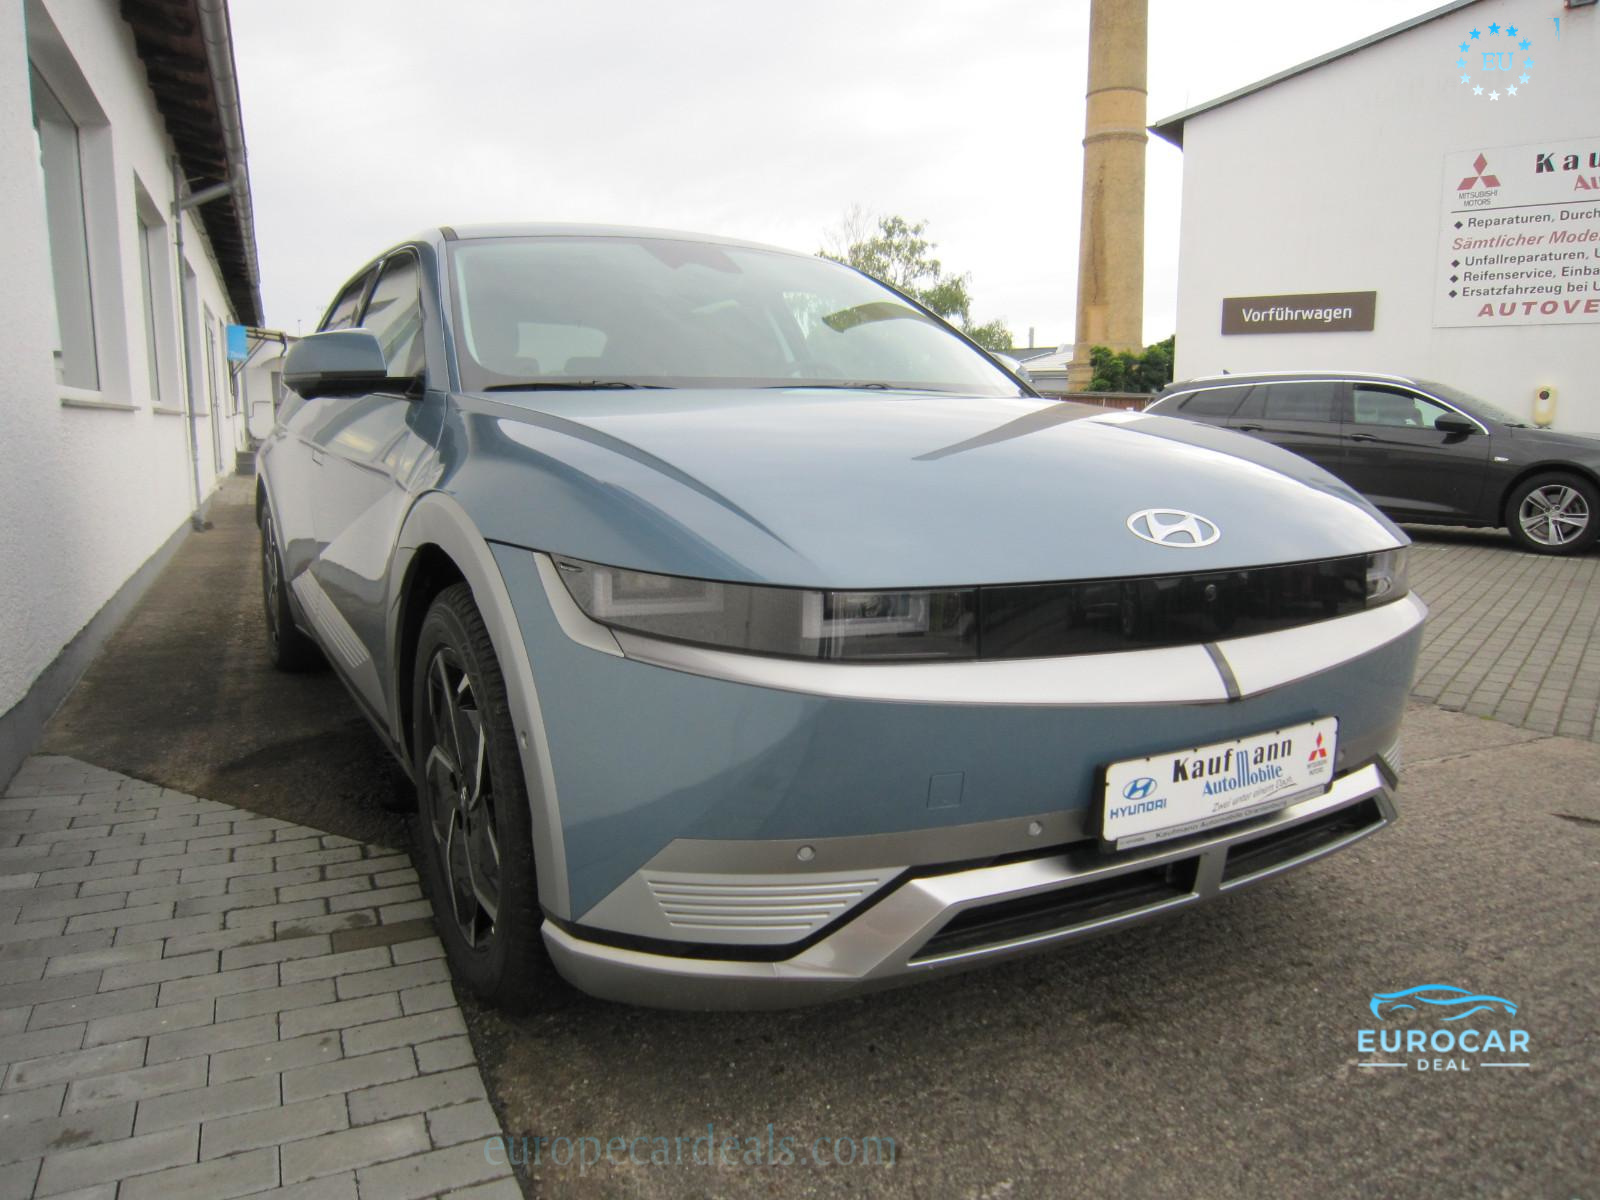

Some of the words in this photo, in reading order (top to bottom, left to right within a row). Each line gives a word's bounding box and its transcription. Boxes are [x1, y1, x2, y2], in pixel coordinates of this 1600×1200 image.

[1458, 190, 1498, 200] MITSUBISHI
[1463, 199, 1492, 207] MOTORS
[1467, 212, 1555, 229] Reparaturen,
[1560, 207, 1600, 221] Durch
[1452, 233, 1545, 251] Sämtlicher
[1548, 228, 1600, 244] Mode
[1464, 249, 1590, 267] Unfallreparaturen,
[1463, 266, 1557, 282] Reifenservice,
[1561, 265, 1600, 278] Einba
[1462, 283, 1563, 297] Ersatzfahrzeug
[1566, 280, 1589, 293] bei
[1241, 306, 1353, 323] Vorführwagen
[1477, 298, 1600, 317] AUTOVE
[1110, 798, 1168, 820] HYUNDAI
